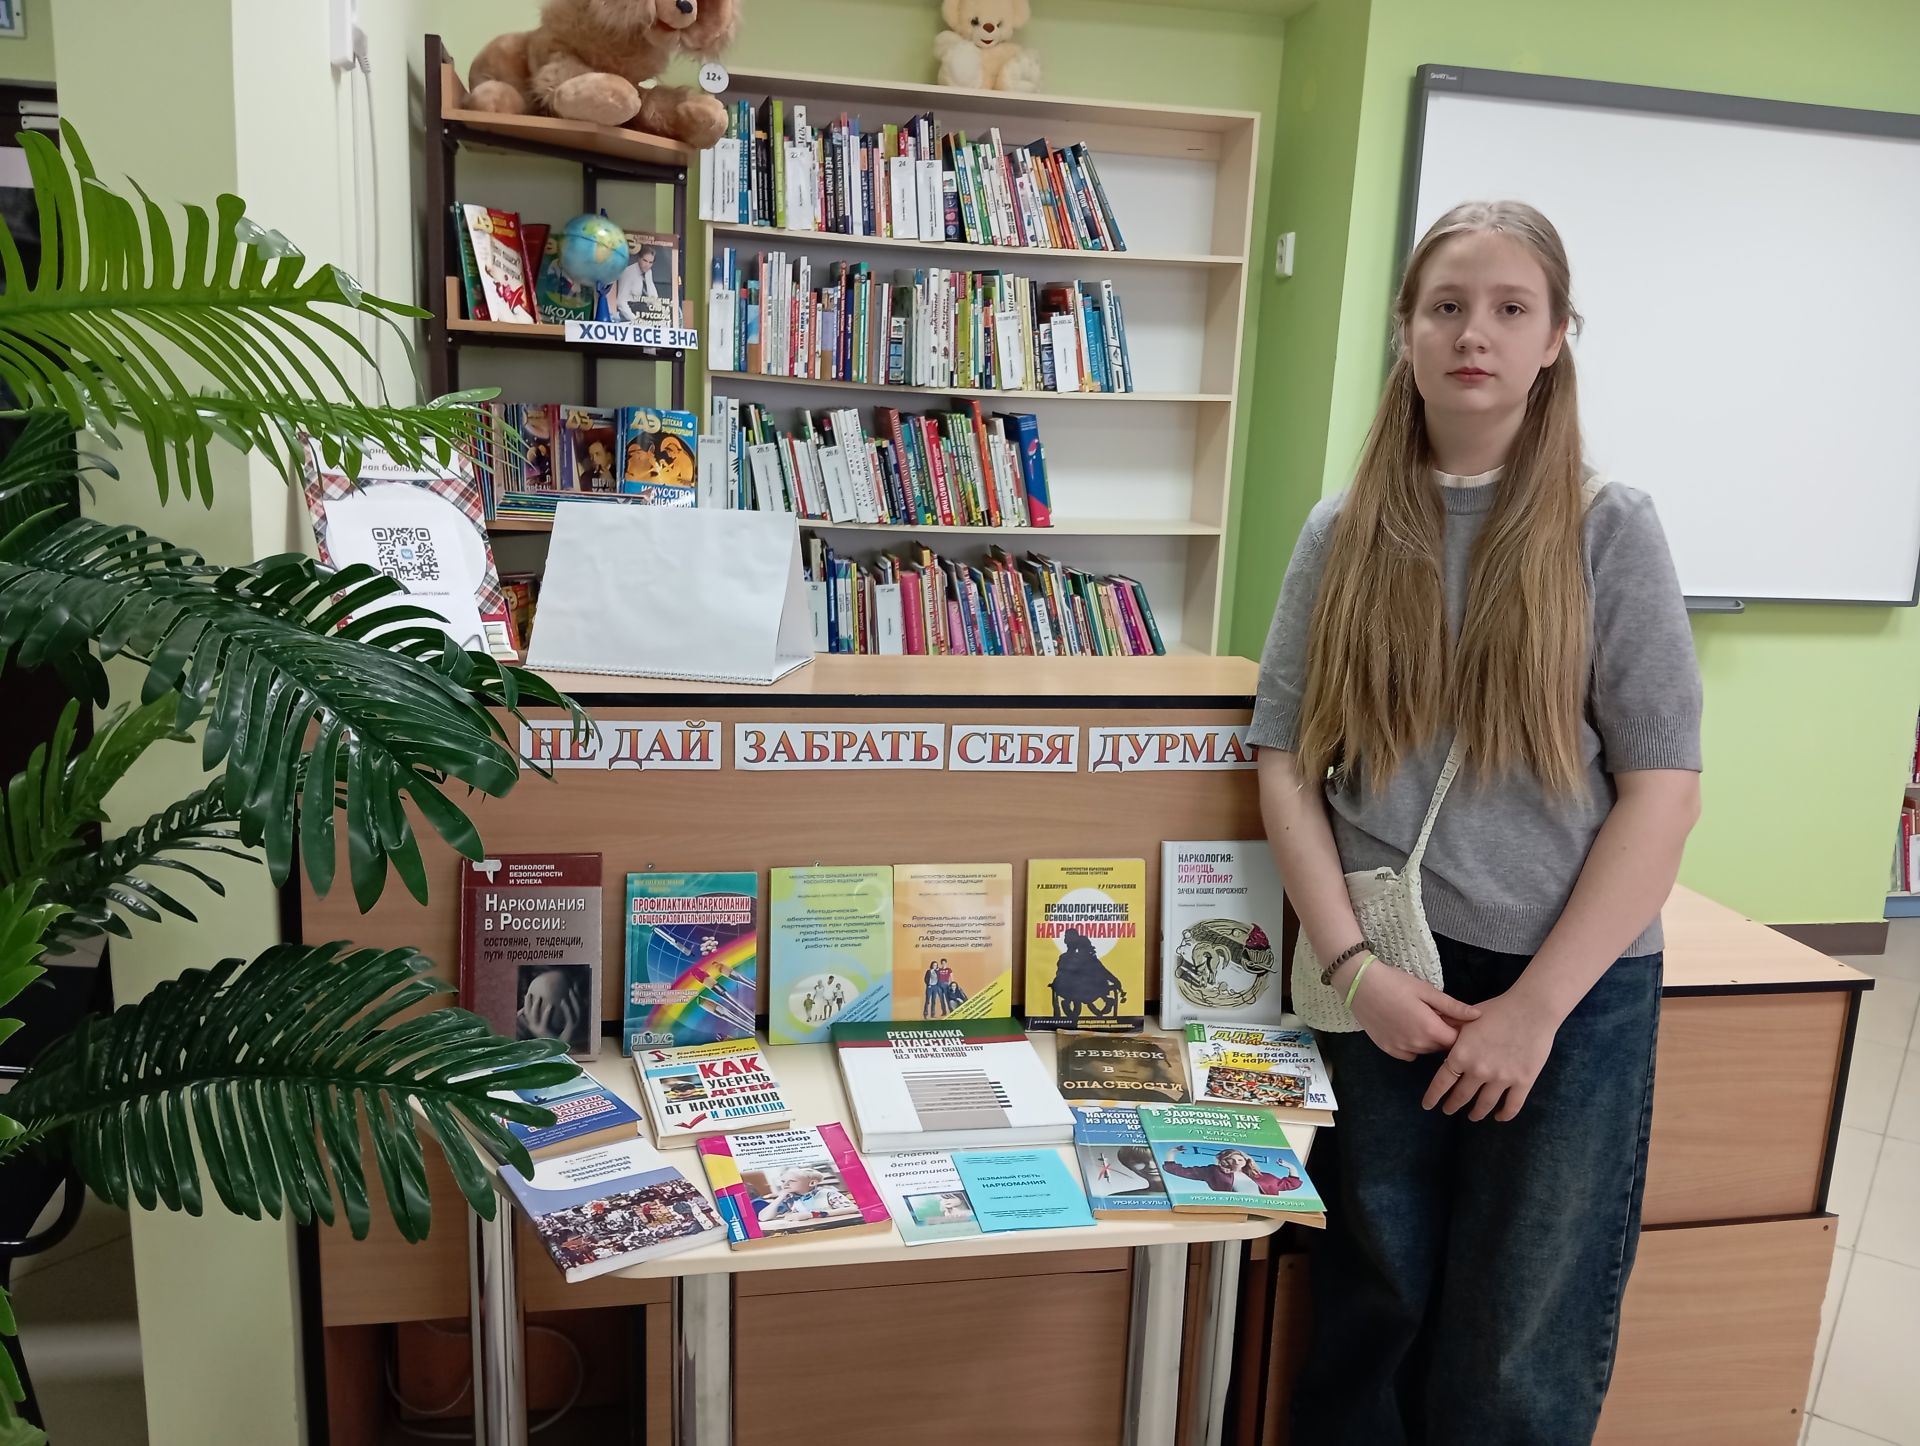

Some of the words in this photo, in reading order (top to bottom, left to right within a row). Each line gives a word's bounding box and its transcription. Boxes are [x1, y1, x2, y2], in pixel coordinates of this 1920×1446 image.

[706, 72, 722, 81] 12+
[640, 312, 670, 320] РУССКОЙ
[579, 323, 629, 342] ХОЧУ
[633, 325, 662, 345] ВСЁ
[668, 330, 698, 347] ЗНА
[566, 409, 594, 431] ДЭ
[631, 410, 662, 434] ДЭ
[938, 476, 951, 515] ЖИВОТНЫЕ
[527, 727, 597, 762] НЕ
[608, 719, 714, 770] ДАЙ
[743, 729, 939, 764] ЗАБРАТЬ
[957, 731, 1073, 765] СЕБЯ
[1178, 853, 1234, 863] НАРКОЛОГИЯ:
[1178, 864, 1215, 874] ПОМОЩЬ
[1178, 875, 1195, 884] ИЛИ
[1197, 874, 1233, 885] УТОПИЯ?
[1177, 887, 1195, 895] ЗАЧЕМ
[1195, 887, 1215, 895] КОШКЕ
[633, 897, 697, 912] ПРОФИЛАКТИКА
[697, 896, 751, 912] НАРКОМАНИИ
[1044, 903, 1129, 913] ПСИХОЛОГИЧЕСКИЕ
[632, 914, 637, 925] В
[638, 913, 711, 925] ОБЩЕОБРАЗОВАТЕЛЬНОМ
[711, 912, 751, 925] УЧРЕЖДЕНИИ
[1044, 914, 1075, 922] ОСНОВЫ
[1075, 914, 1129, 922] ПРОФИЛАКТИКИ
[484, 935, 531, 949] состояние,
[535, 935, 584, 948] тенденции,
[483, 951, 504, 962] пути
[507, 949, 564, 961] преодоления
[886, 1029, 965, 1040] РЕСПУБЛИКА
[1210, 1030, 1264, 1041] ДЛЯ
[888, 1038, 966, 1048] ТАТАРСТАН:
[942, 1045, 984, 1053] ОБЩЕСТВУ
[914, 1051, 968, 1059] НАРКОТИКОВ
[698, 1057, 764, 1079] КАК
[1102, 1065, 1115, 1073] В
[706, 1073, 771, 1089] УБЕРЕЧЬ
[1063, 1080, 1184, 1092] ОПАСНОСТИ
[710, 1081, 775, 1097] ДЕТЕЙ
[665, 1104, 682, 1115] ОТ
[689, 1092, 781, 1112] НАРКОТИКОВ
[1309, 1093, 1327, 1102] АСТ
[710, 1110, 719, 1119] И
[725, 1101, 786, 1117] АЛКОГОЛЯ
[1164, 1110, 1231, 1121] ЗДОРОВОМ
[1231, 1113, 1266, 1122] ТЕЛЕ-
[1163, 1117, 1232, 1127] ЗДОРОВЫЙ
[1236, 1121, 1261, 1130] ДУХ
[732, 1134, 763, 1142] Твоя
[766, 1129, 807, 1139] жизнь
[1206, 1130, 1248, 1138] КЛАССЫ
[735, 1139, 766, 1148] твой
[769, 1135, 811, 1145] выбор
[557, 1155, 631, 1175] ПСИХОЛОГИЯ
[565, 1160, 632, 1178] ЗАВИСИМОЙ
[890, 1159, 927, 1168] детей
[573, 1165, 631, 1182] ЛИЧНОСТИ
[884, 1167, 956, 1178] наркотиков
[982, 1179, 1047, 1188] НАРКОМАНИЯ
